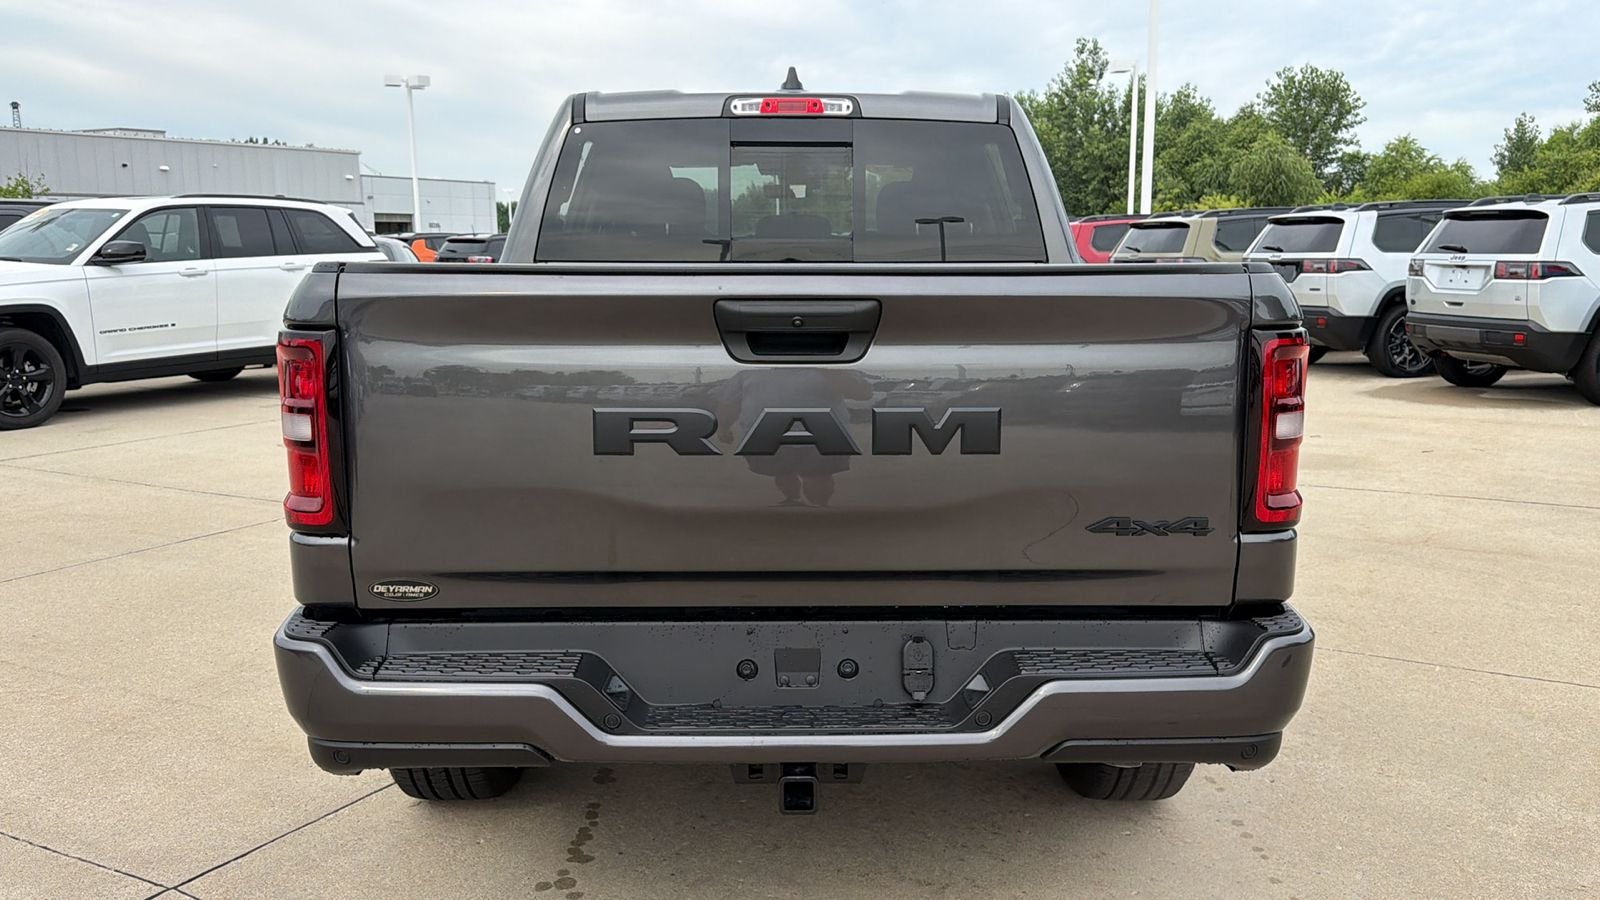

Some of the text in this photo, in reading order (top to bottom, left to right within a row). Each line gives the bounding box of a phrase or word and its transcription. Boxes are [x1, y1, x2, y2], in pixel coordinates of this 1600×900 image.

[99, 327, 127, 335] GRAND
[128, 323, 169, 332] CHEROKEE
[592, 407, 1002, 456] RAM
[373, 584, 433, 593] DEYARMAN
